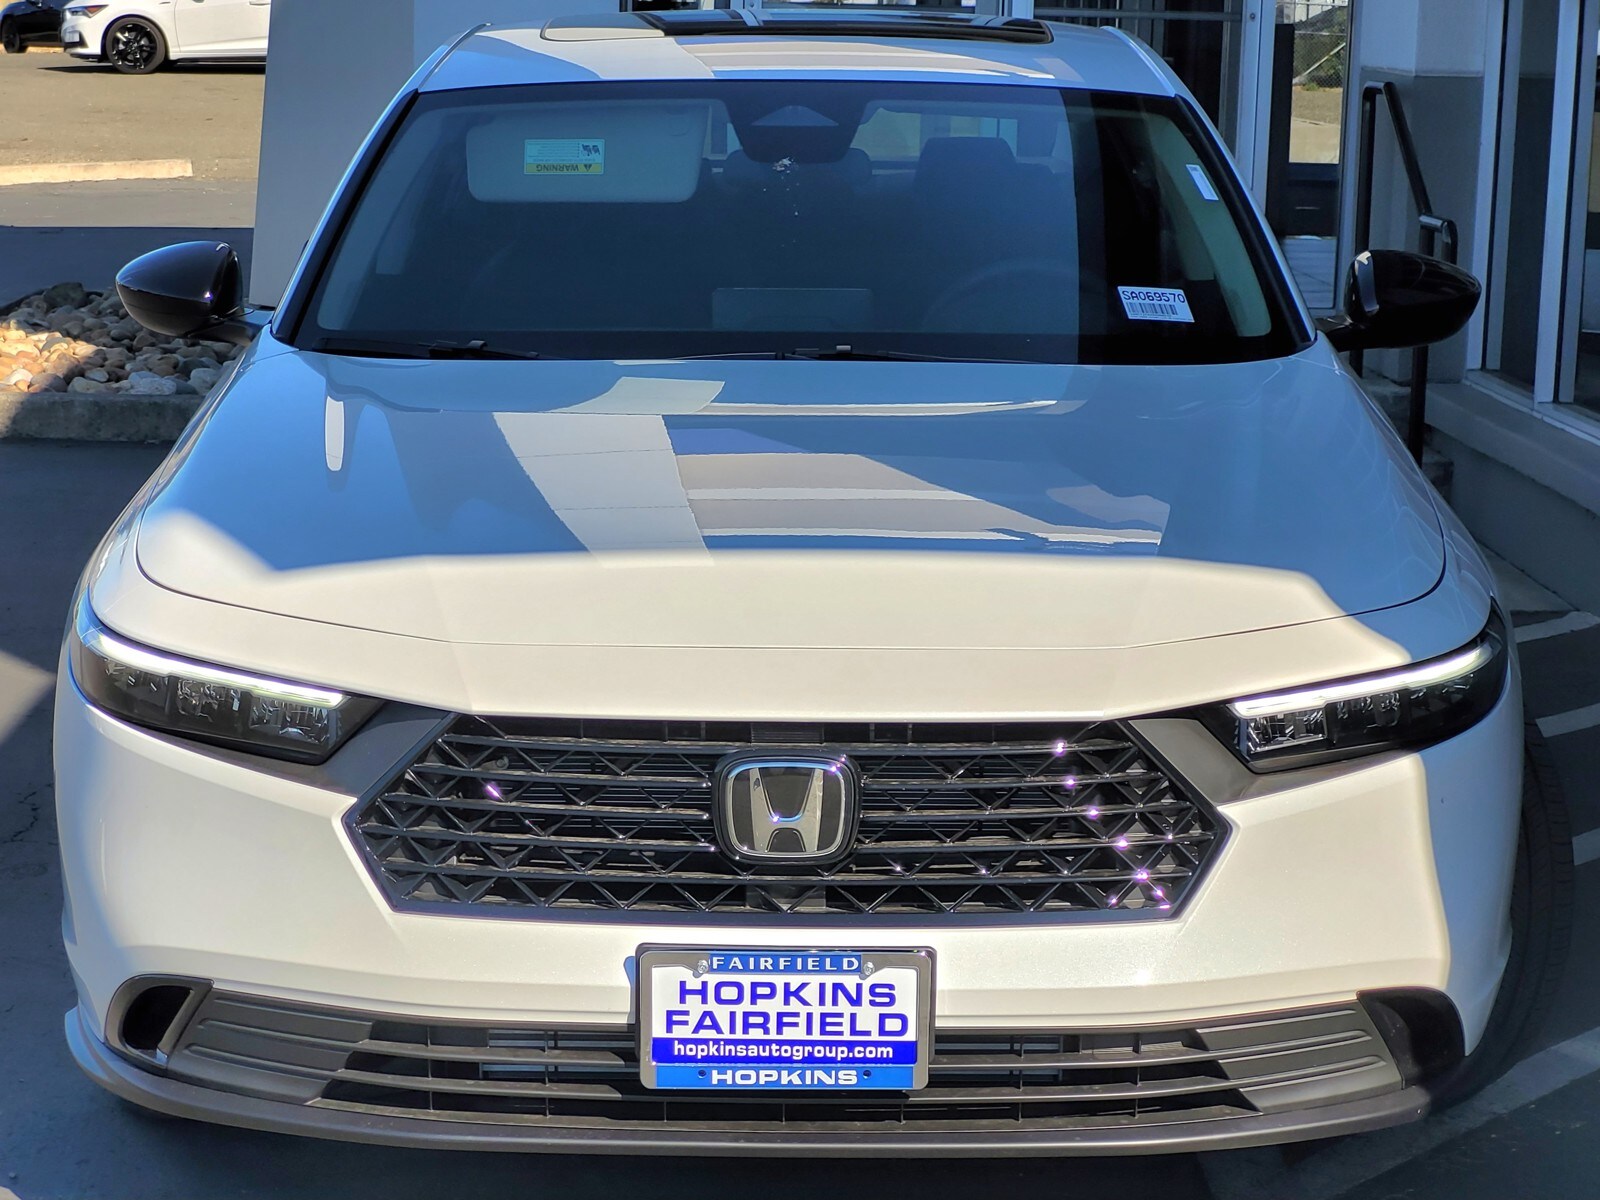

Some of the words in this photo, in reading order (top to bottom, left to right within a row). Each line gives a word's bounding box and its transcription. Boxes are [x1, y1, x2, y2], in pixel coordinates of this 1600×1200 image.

[536, 163, 579, 172] WARNING
[1121, 290, 1186, 304] SA069570
[712, 956, 859, 971] FAIRFIELD
[679, 980, 897, 1008] HOPKINS
[665, 1009, 909, 1037] FAIRFIELD
[673, 1040, 893, 1060] hopkinsautogroup.com
[711, 1069, 858, 1086] HOPKINS
